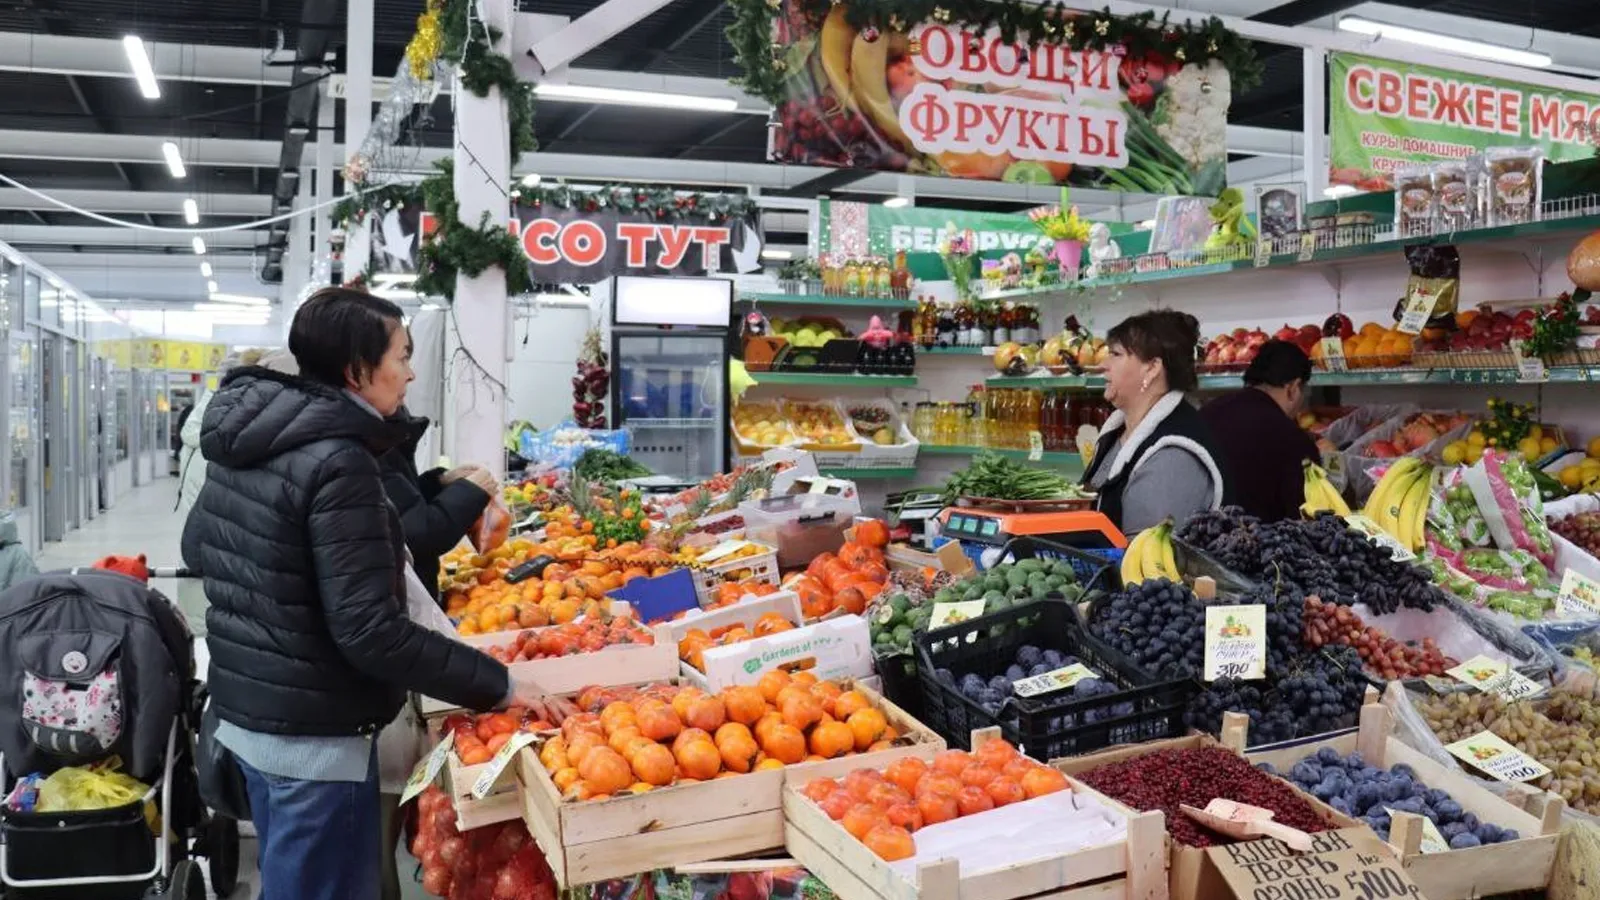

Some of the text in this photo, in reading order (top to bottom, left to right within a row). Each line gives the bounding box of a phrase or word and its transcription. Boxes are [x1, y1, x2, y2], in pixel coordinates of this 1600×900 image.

[919, 24, 1112, 95] ОВОЩИ
[1348, 67, 1520, 133] СВЕЖЕЕ
[909, 93, 1119, 158] ФРУКТЫ
[1361, 132, 1398, 150] КУРЫ
[618, 223, 731, 270] ТУТ
[761, 646, 800, 662] Gardens
[1224, 831, 1353, 865] КЛЮВА
